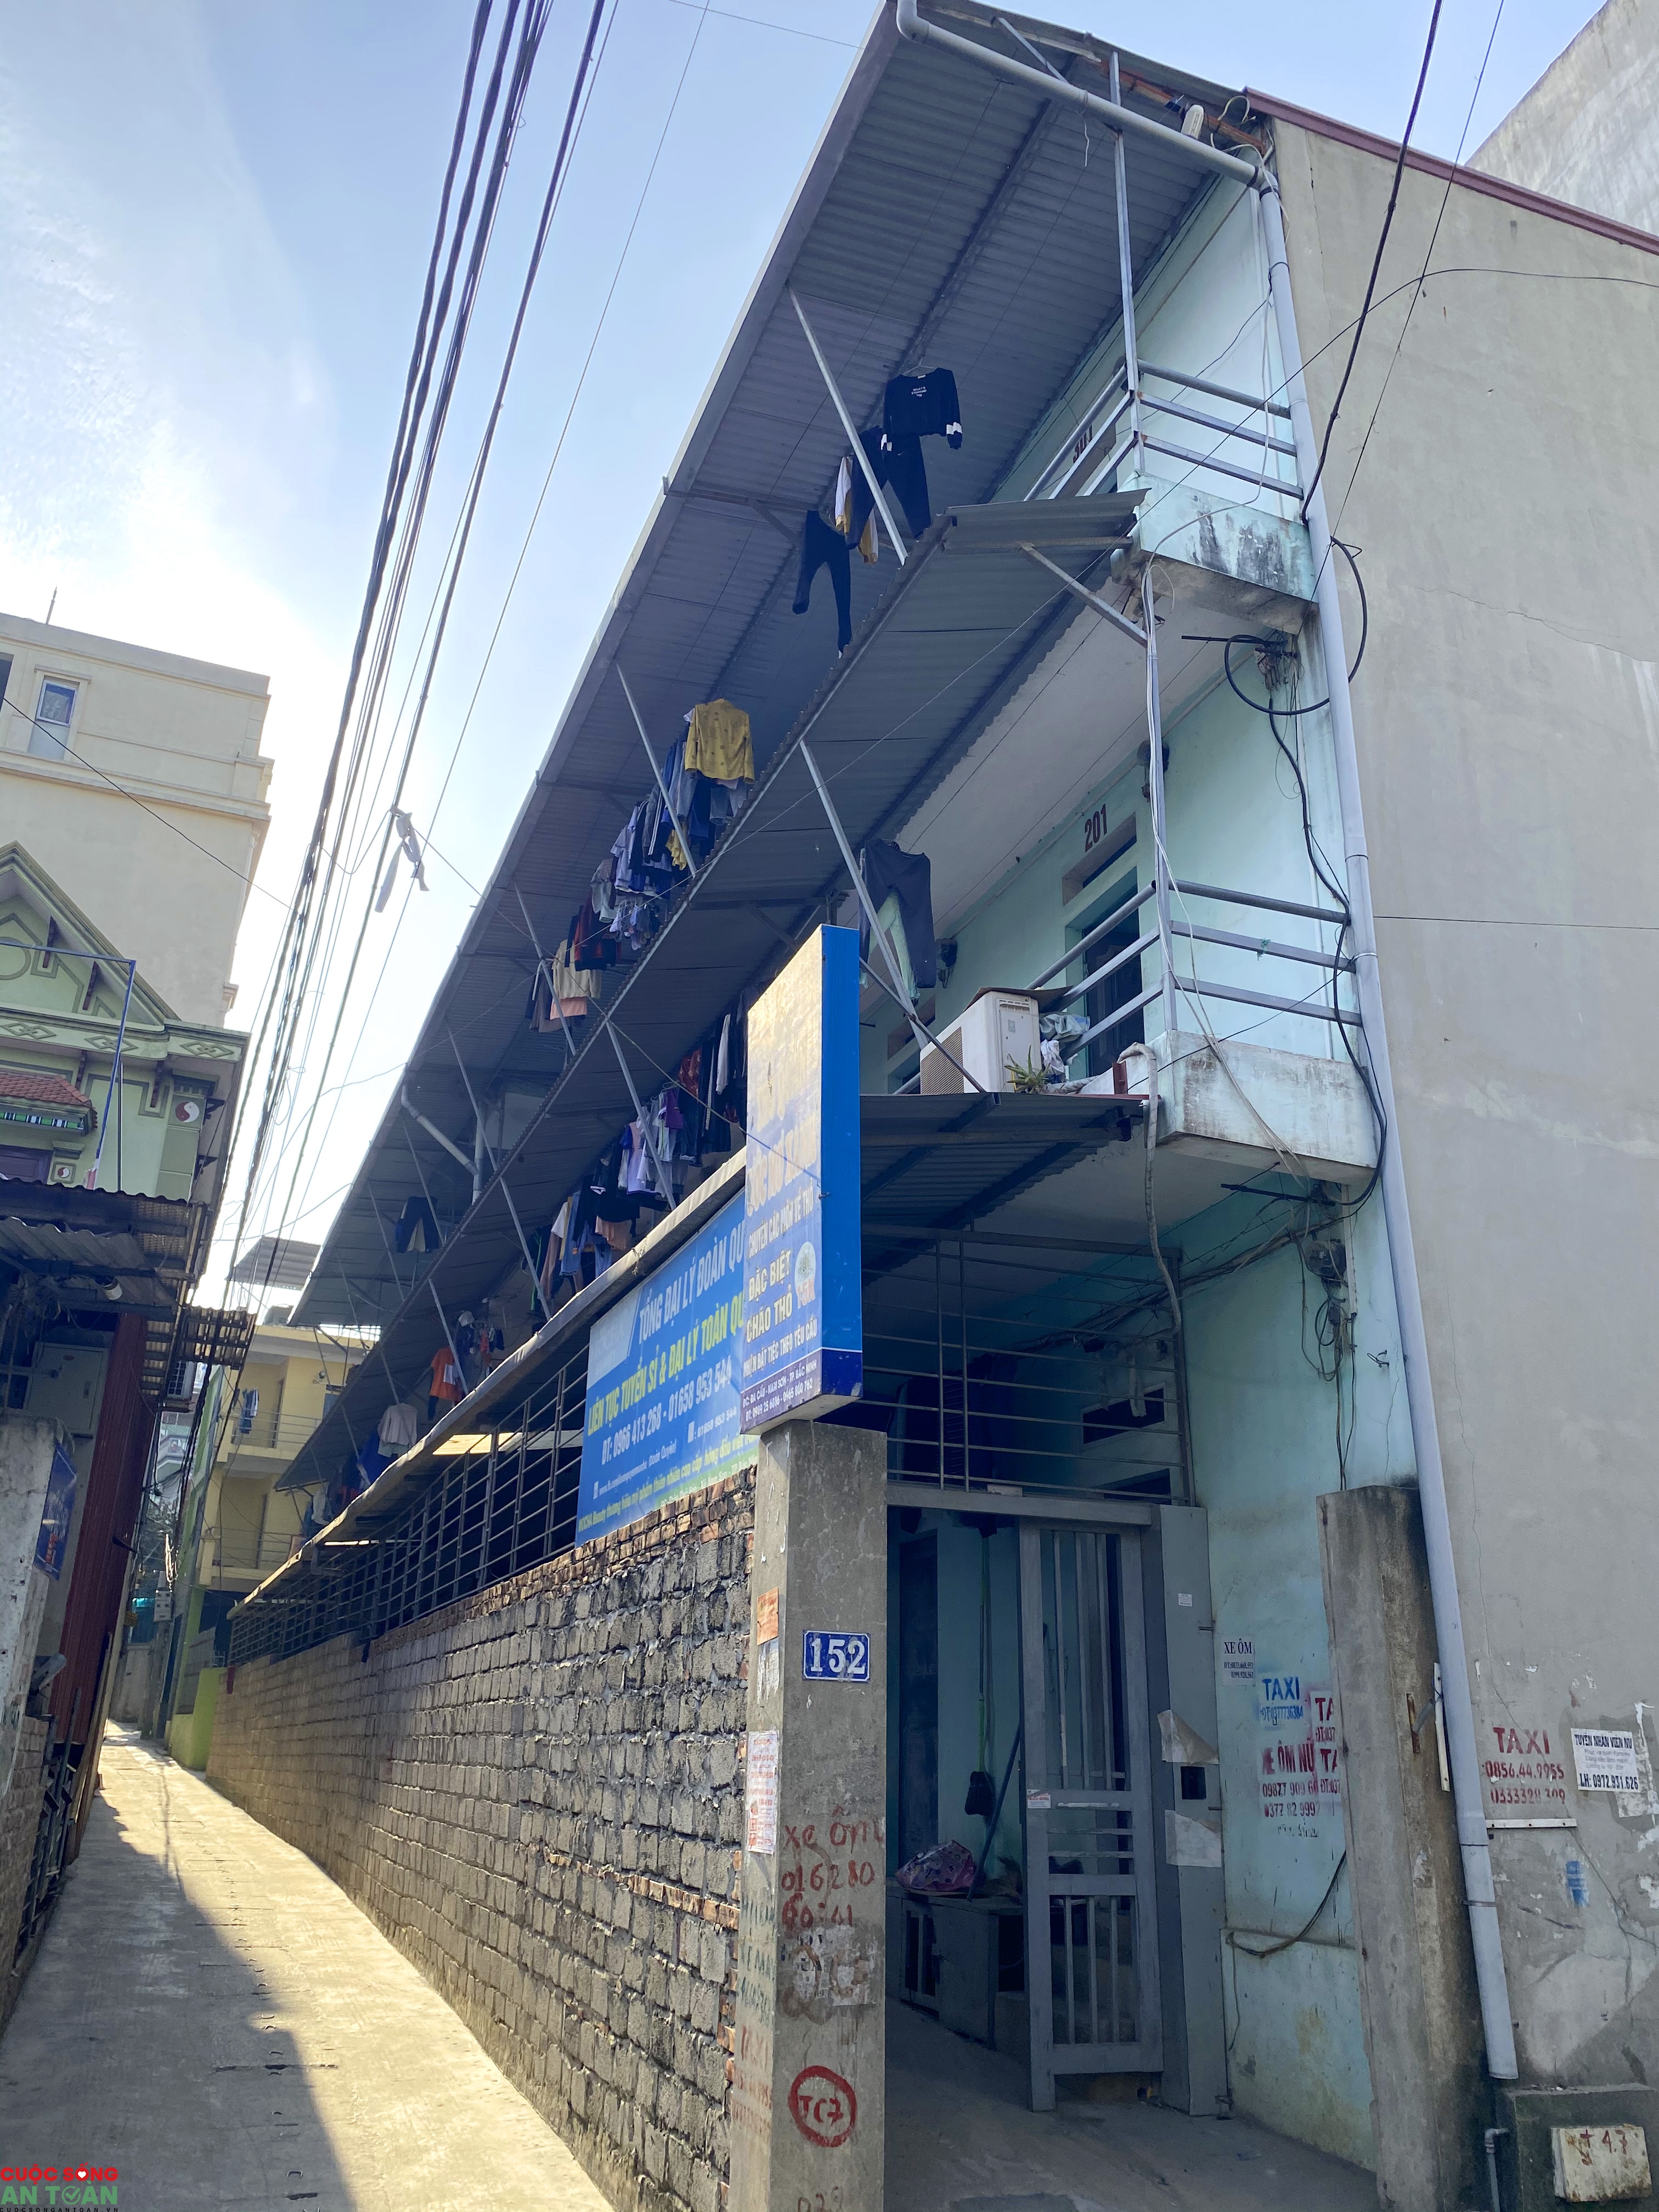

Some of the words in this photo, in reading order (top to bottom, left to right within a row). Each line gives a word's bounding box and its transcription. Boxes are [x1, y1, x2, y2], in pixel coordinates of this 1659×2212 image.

[1085, 804, 1107, 853] 201
[639, 1288, 663, 1344] TỔNG
[664, 1276, 681, 1327] ĐẠI
[682, 1256, 696, 1309] LÝ
[697, 1237, 727, 1297] ĐOÀN
[748, 1267, 767, 1302] ĐẶC
[770, 1249, 791, 1287] BIỆT
[746, 1305, 771, 1343] CHÁO
[774, 1284, 792, 1326] THỎ
[768, 1340, 779, 1365] TIỆC
[780, 1333, 793, 1357] THEO
[794, 1324, 805, 1348] YÊU
[588, 1396, 604, 1436] LIÊN
[605, 1386, 619, 1429] TỤC
[621, 1357, 647, 1412] TUYỂN
[659, 1352, 667, 1385] &
[668, 1336, 685, 1381] ĐẠI
[686, 1318, 699, 1365] LÝ
[701, 1303, 728, 1355] TOÀN
[768, 1382, 777, 1395] NAM
[795, 1363, 805, 1379] BẮC
[805, 1359, 817, 1374] NINH
[804, 1378, 813, 1392] 762
[613, 1424, 630, 1457] 0966
[631, 1413, 646, 1445] 413
[646, 1402, 662, 1437] 268
[668, 1380, 694, 1422] 01658
[696, 1368, 712, 1404] 953
[714, 1355, 732, 1392] 544
[811, 1638, 865, 1674] 152
[1224, 1642, 1235, 1654] XE
[1238, 1638, 1252, 1655] ÔM
[1262, 1677, 1300, 1701] TAXI
[1493, 1727, 1550, 1754] TAXI
[1580, 1773, 1592, 1787] LH:
